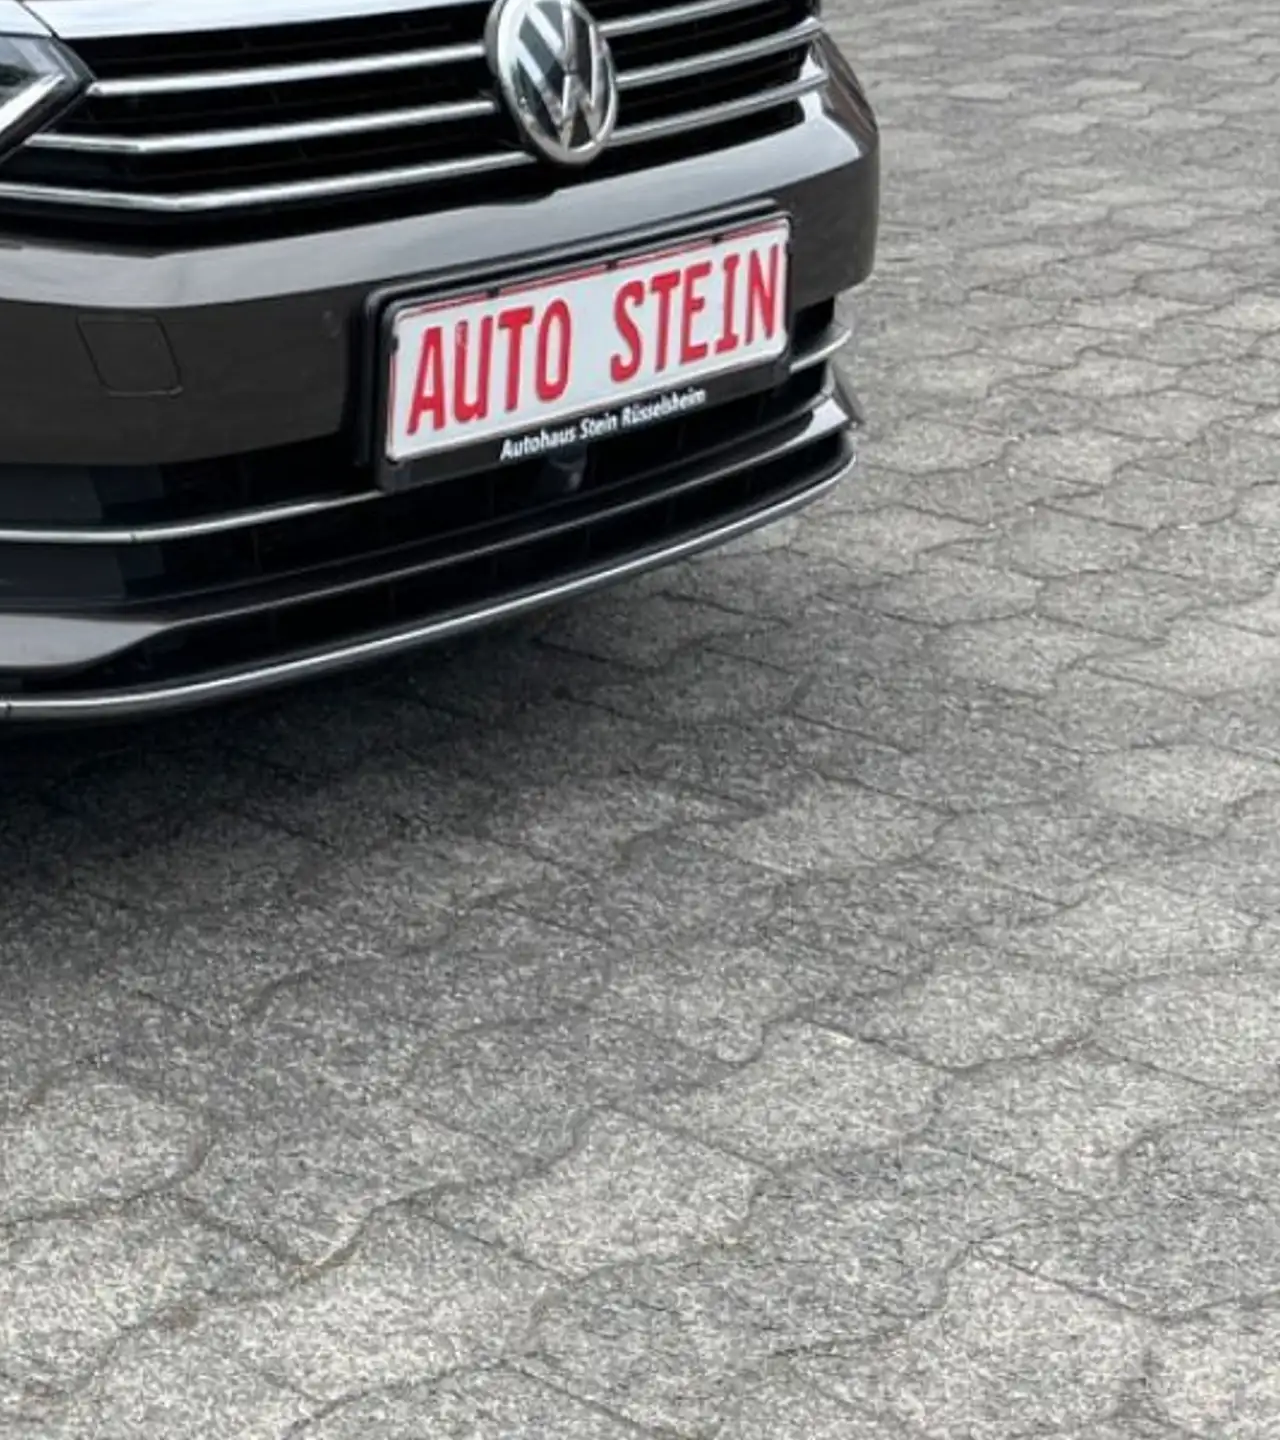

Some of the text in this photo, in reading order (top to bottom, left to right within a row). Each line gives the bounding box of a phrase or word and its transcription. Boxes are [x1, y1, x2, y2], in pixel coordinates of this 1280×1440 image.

[406, 243, 784, 436] AUTO STEIN
[500, 386, 707, 461] Autohaus Stein Rüsselsheim
